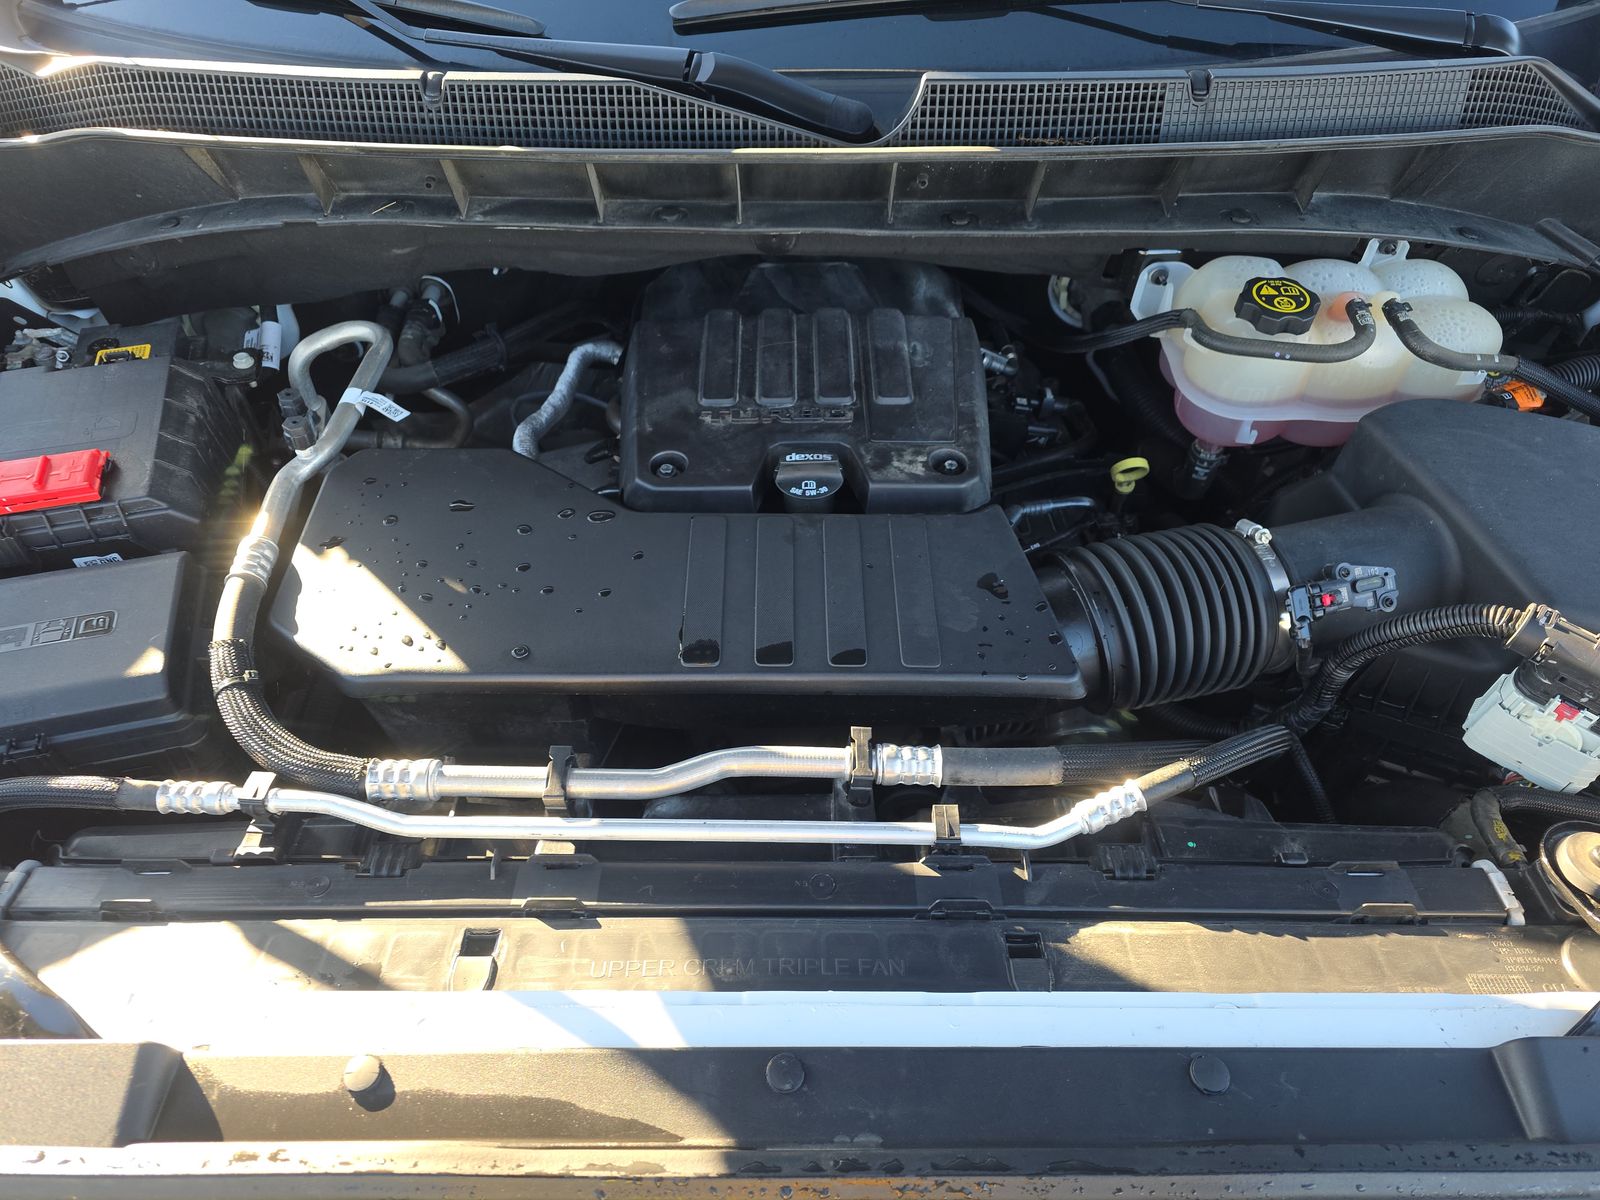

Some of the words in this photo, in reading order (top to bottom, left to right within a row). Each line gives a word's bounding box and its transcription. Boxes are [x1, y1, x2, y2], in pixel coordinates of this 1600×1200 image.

[785, 452, 832, 461] dexos
[789, 487, 803, 496] SAE
[805, 486, 829, 496] 5W-30
[589, 959, 677, 979] UPPER
[761, 957, 850, 977] TRIPLE
[857, 957, 906, 977] FAN
